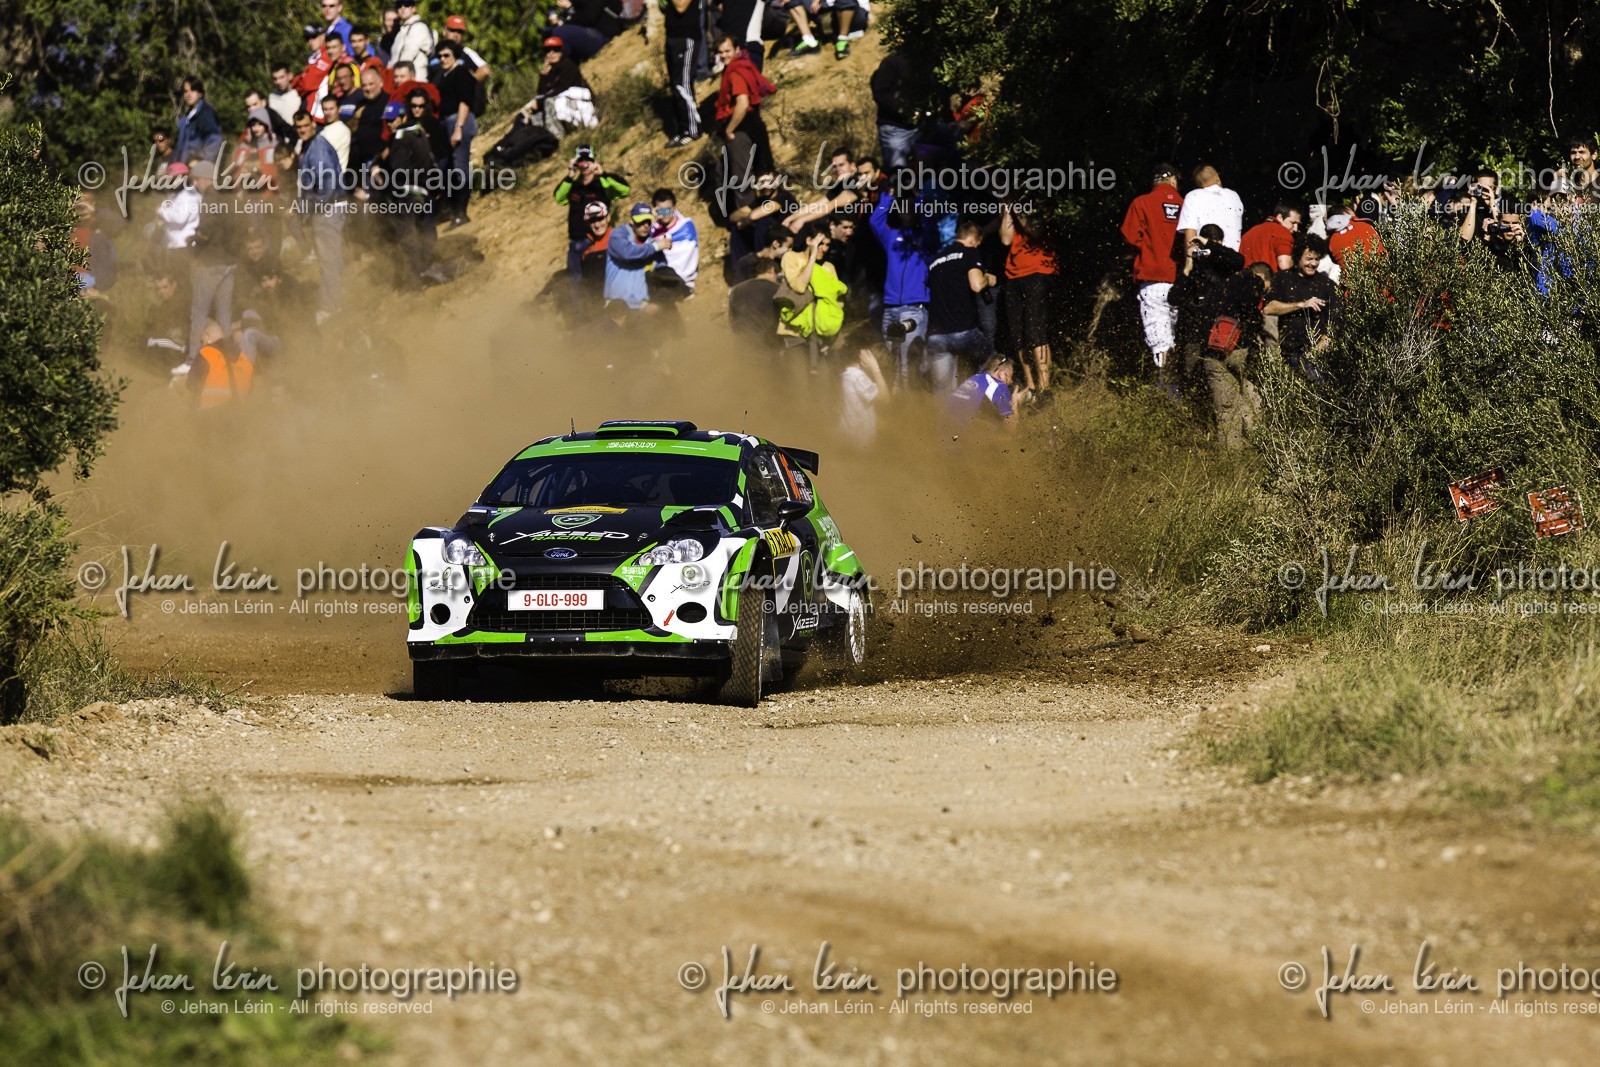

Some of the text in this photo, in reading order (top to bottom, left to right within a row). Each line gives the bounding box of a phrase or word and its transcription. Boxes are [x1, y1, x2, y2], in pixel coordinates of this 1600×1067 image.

[500, 530, 629, 546] YAZEED
[550, 551, 570, 559] Ford
[523, 593, 588, 607] 9-GLG-999
